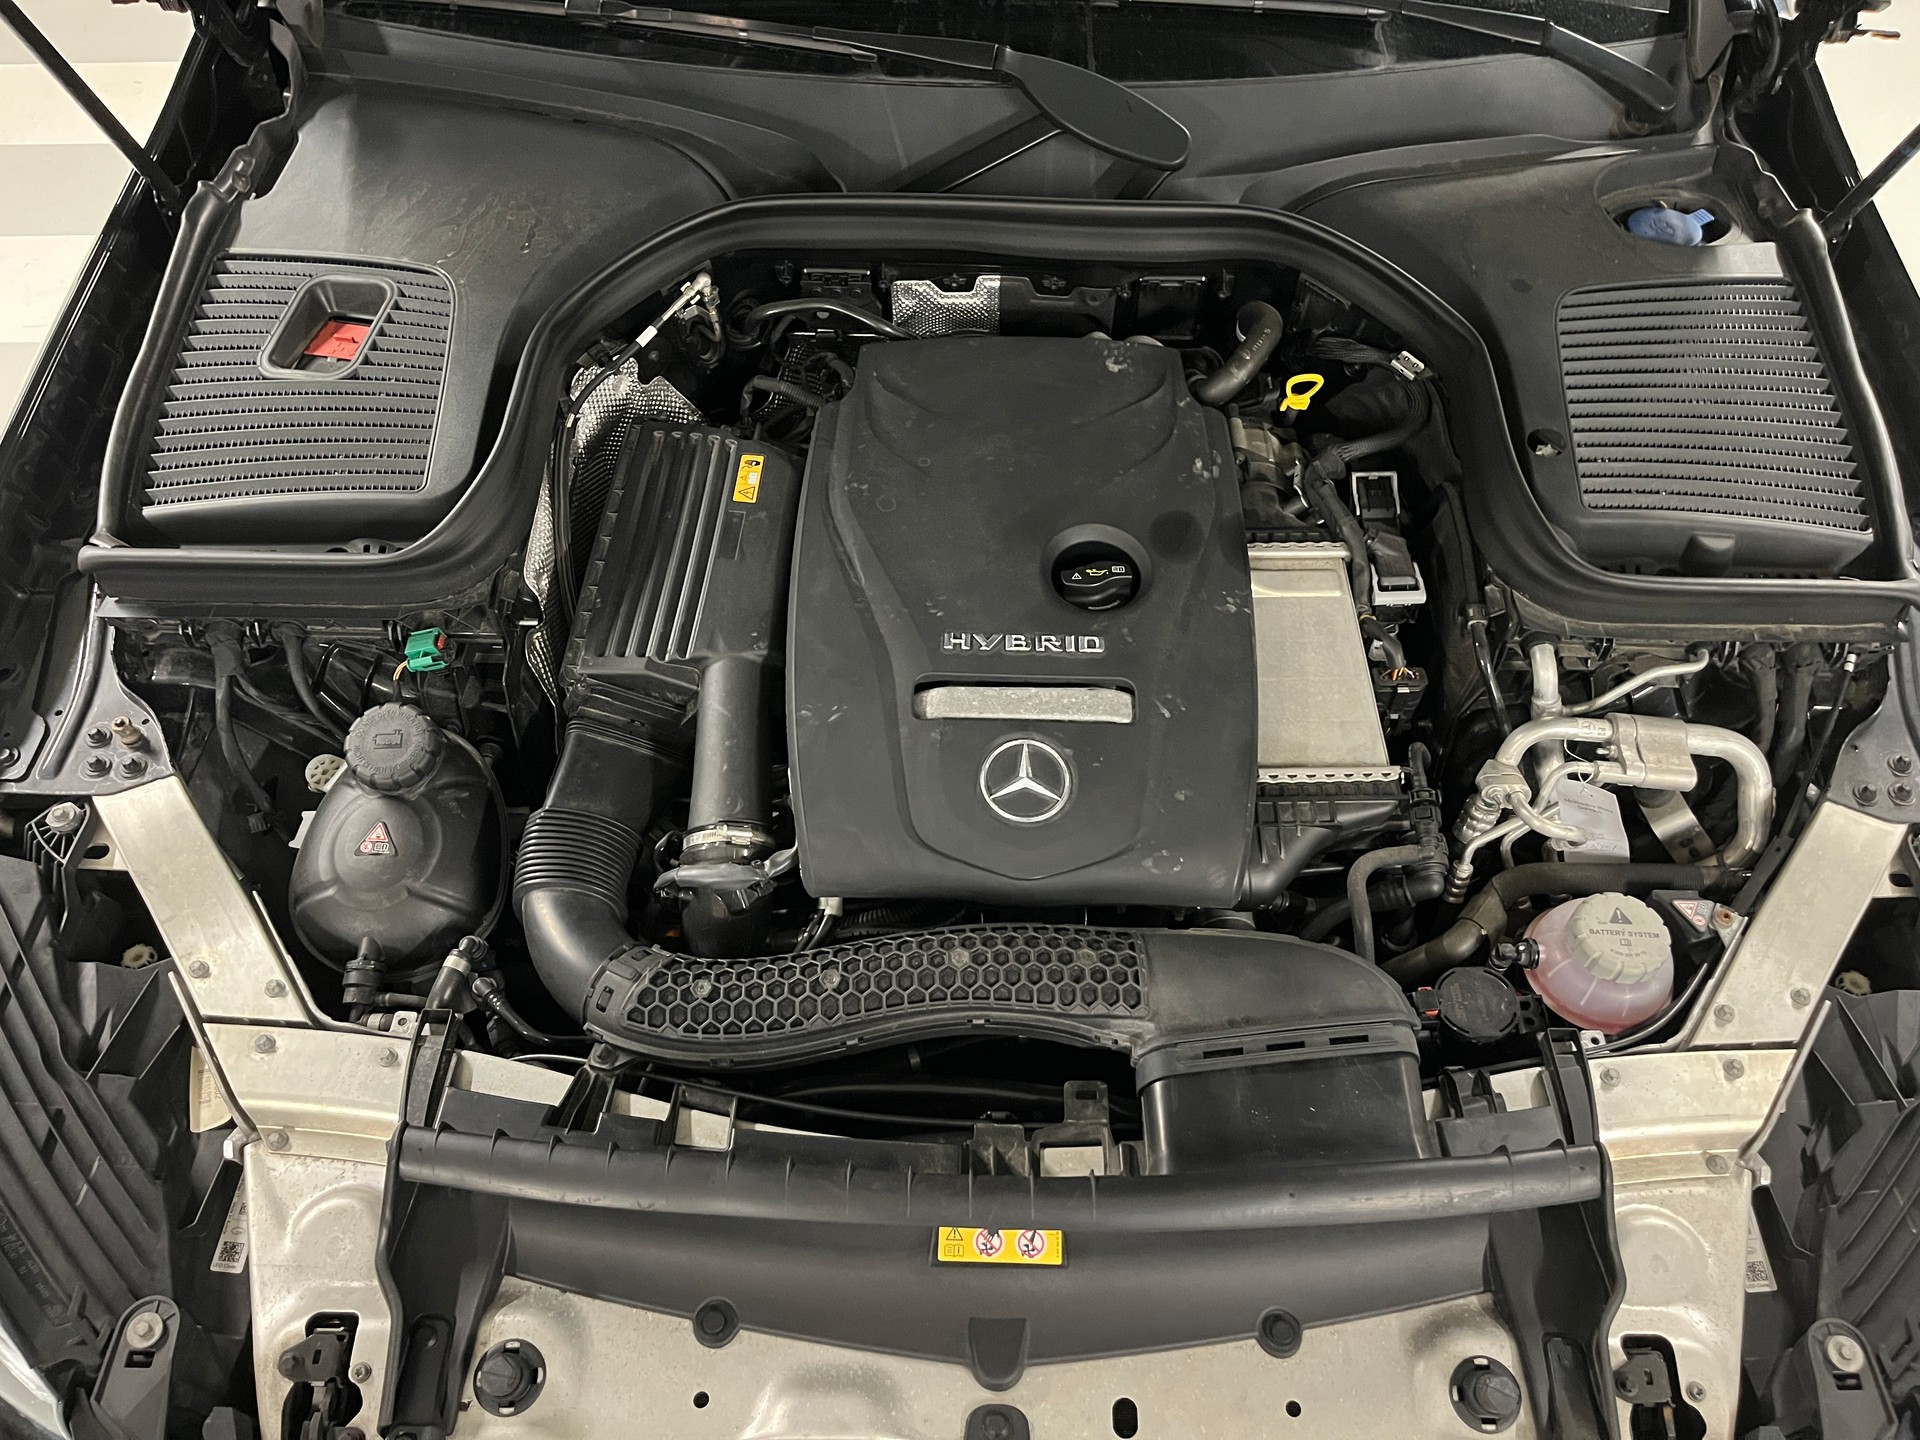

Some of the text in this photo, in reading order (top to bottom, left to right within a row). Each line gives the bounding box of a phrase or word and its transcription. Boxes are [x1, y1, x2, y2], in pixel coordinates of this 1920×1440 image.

[943, 632, 1105, 653] HYBRID
[377, 710, 397, 719] OPEN
[1589, 928, 1660, 939] BATTERY SYSTEM
